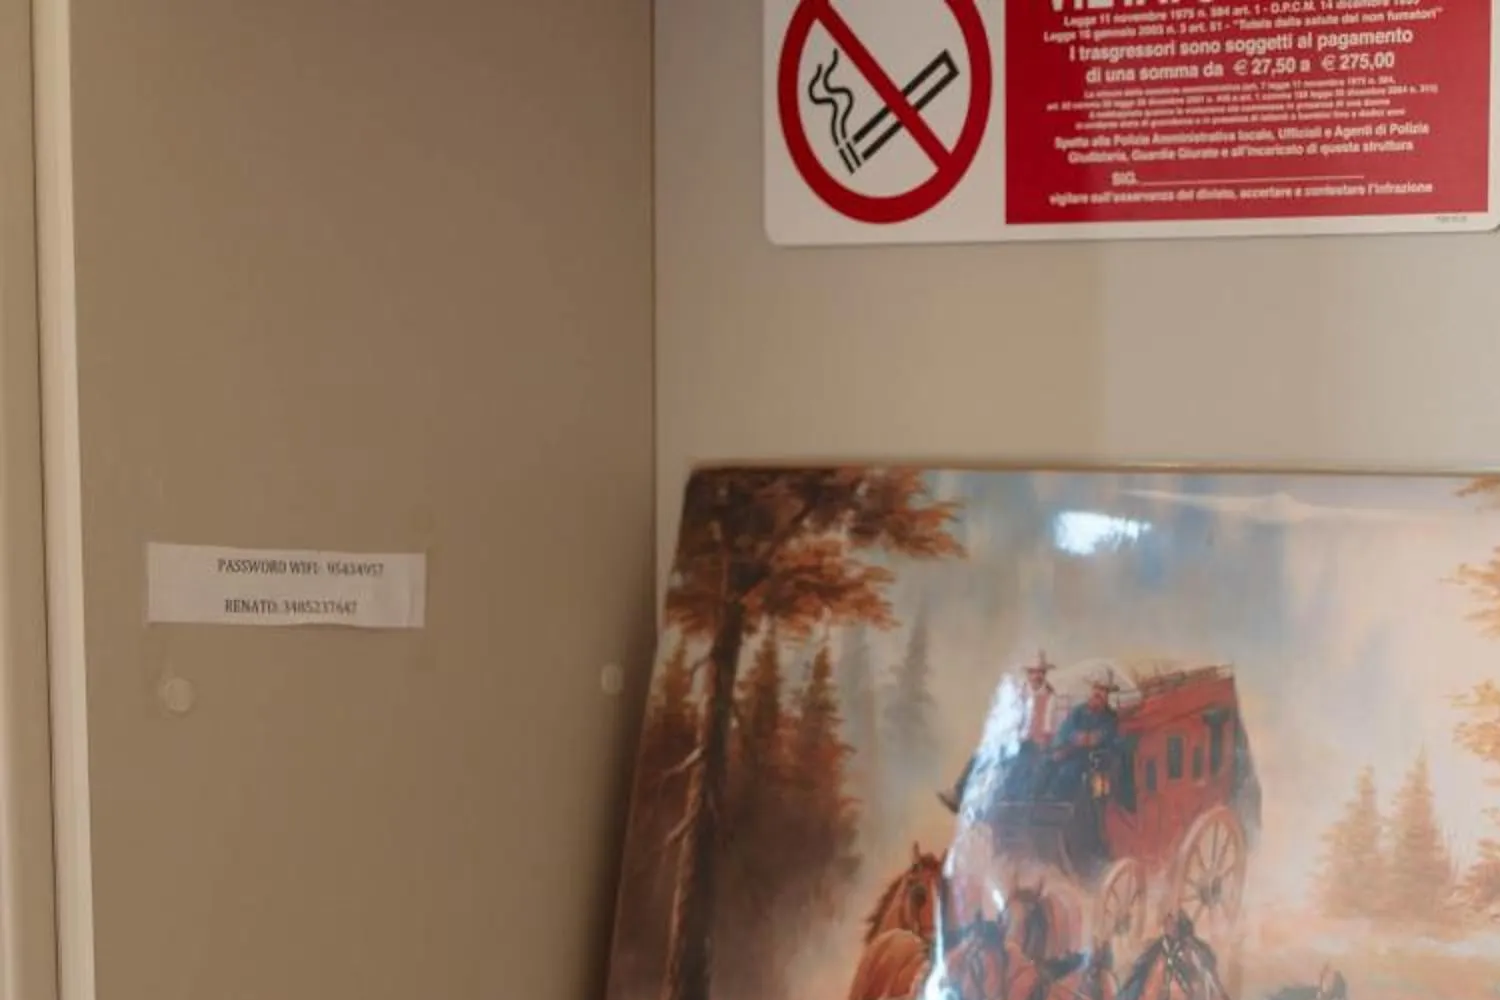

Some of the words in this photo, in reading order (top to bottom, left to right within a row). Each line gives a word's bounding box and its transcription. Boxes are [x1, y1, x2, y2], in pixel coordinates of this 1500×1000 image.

[1068, 45, 1075, 61] I
[1079, 40, 1175, 63] trasgressori
[1179, 40, 1221, 56] sono
[1225, 32, 1293, 55] soggetti
[1297, 32, 1313, 49] al
[1317, 27, 1413, 51] pagamento
[1086, 66, 1100, 83] di
[1105, 67, 1135, 81] una
[1139, 65, 1198, 80] somma
[1202, 61, 1224, 77] da
[1251, 56, 1296, 78] 27,50
[1300, 58, 1311, 73] a
[1339, 51, 1396, 71] 275,00
[1334, 125, 1373, 140] Agenti
[1376, 123, 1387, 135] di
[1389, 121, 1430, 135] Polizia
[1363, 139, 1414, 152] struttura
[217, 558, 287, 574] PASSWORD
